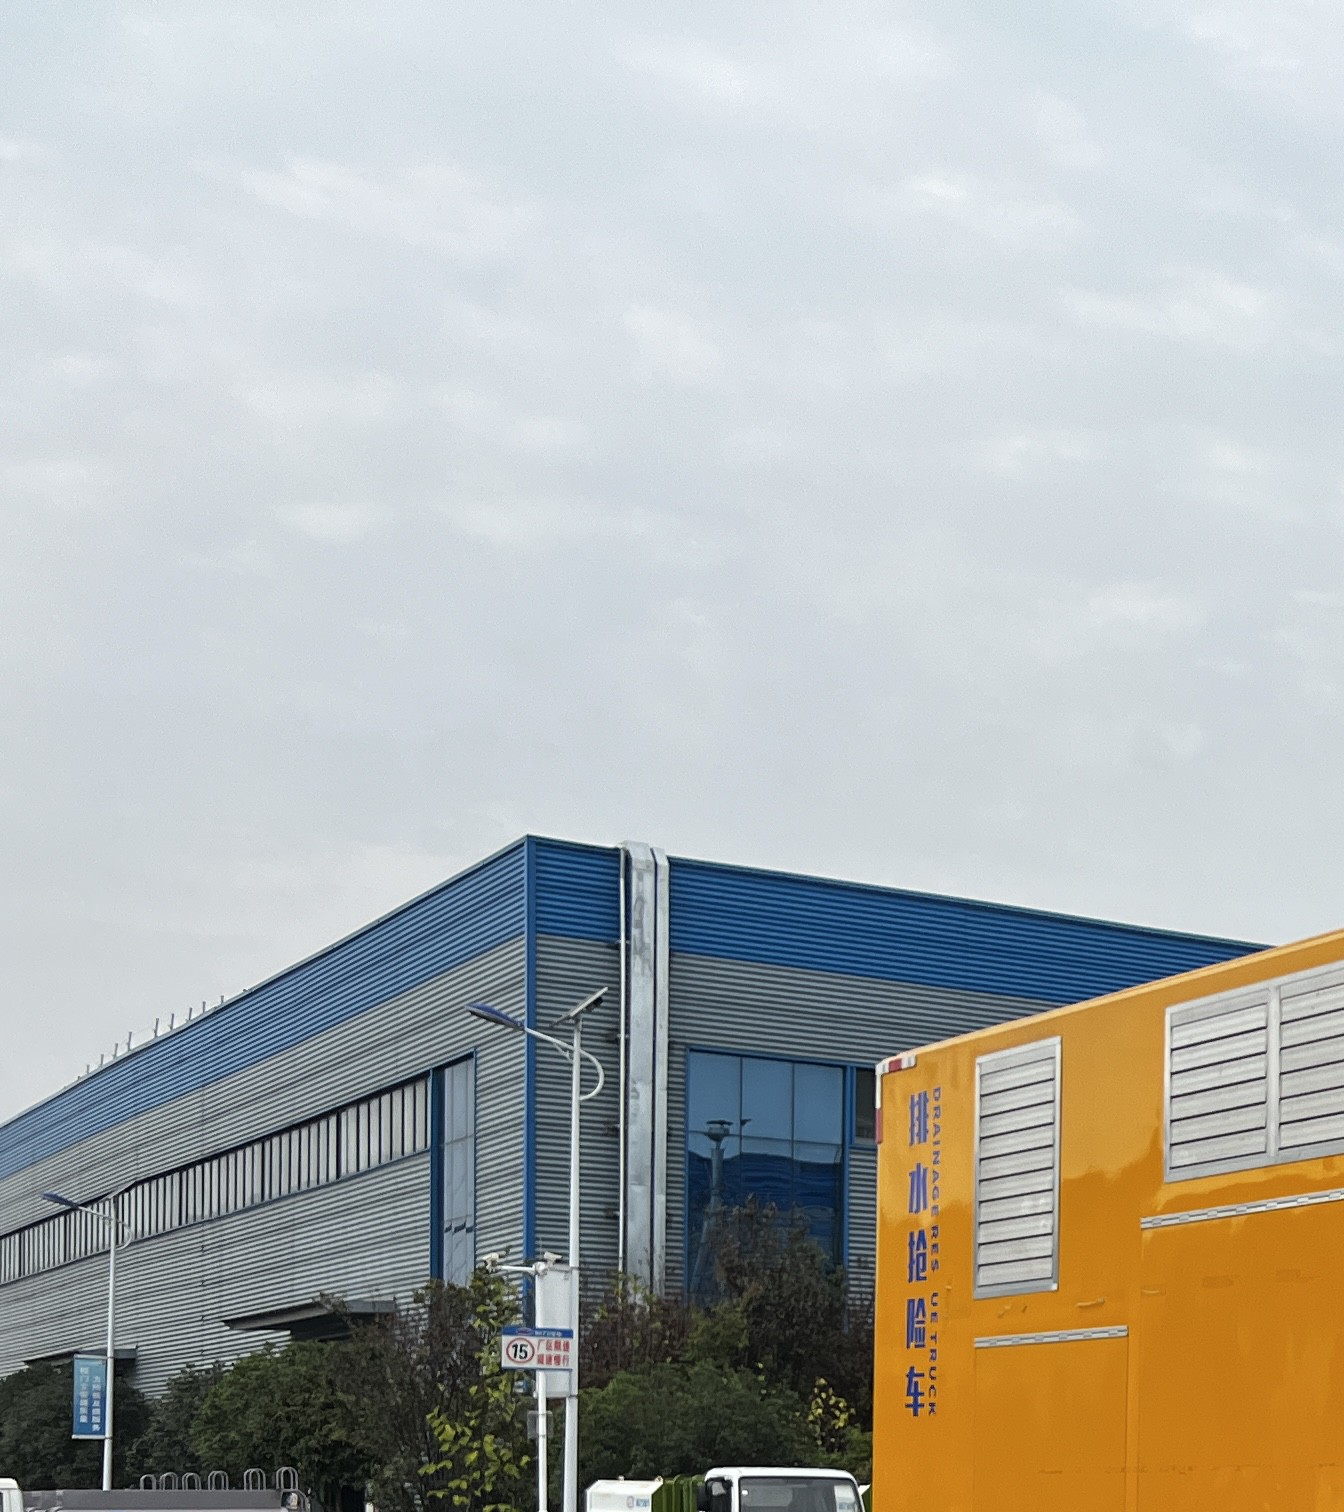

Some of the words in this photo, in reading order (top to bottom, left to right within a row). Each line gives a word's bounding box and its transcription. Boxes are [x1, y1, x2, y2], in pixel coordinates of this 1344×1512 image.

[905, 1090, 929, 1417] 排水抢险车
[511, 1343, 529, 1360] 15
